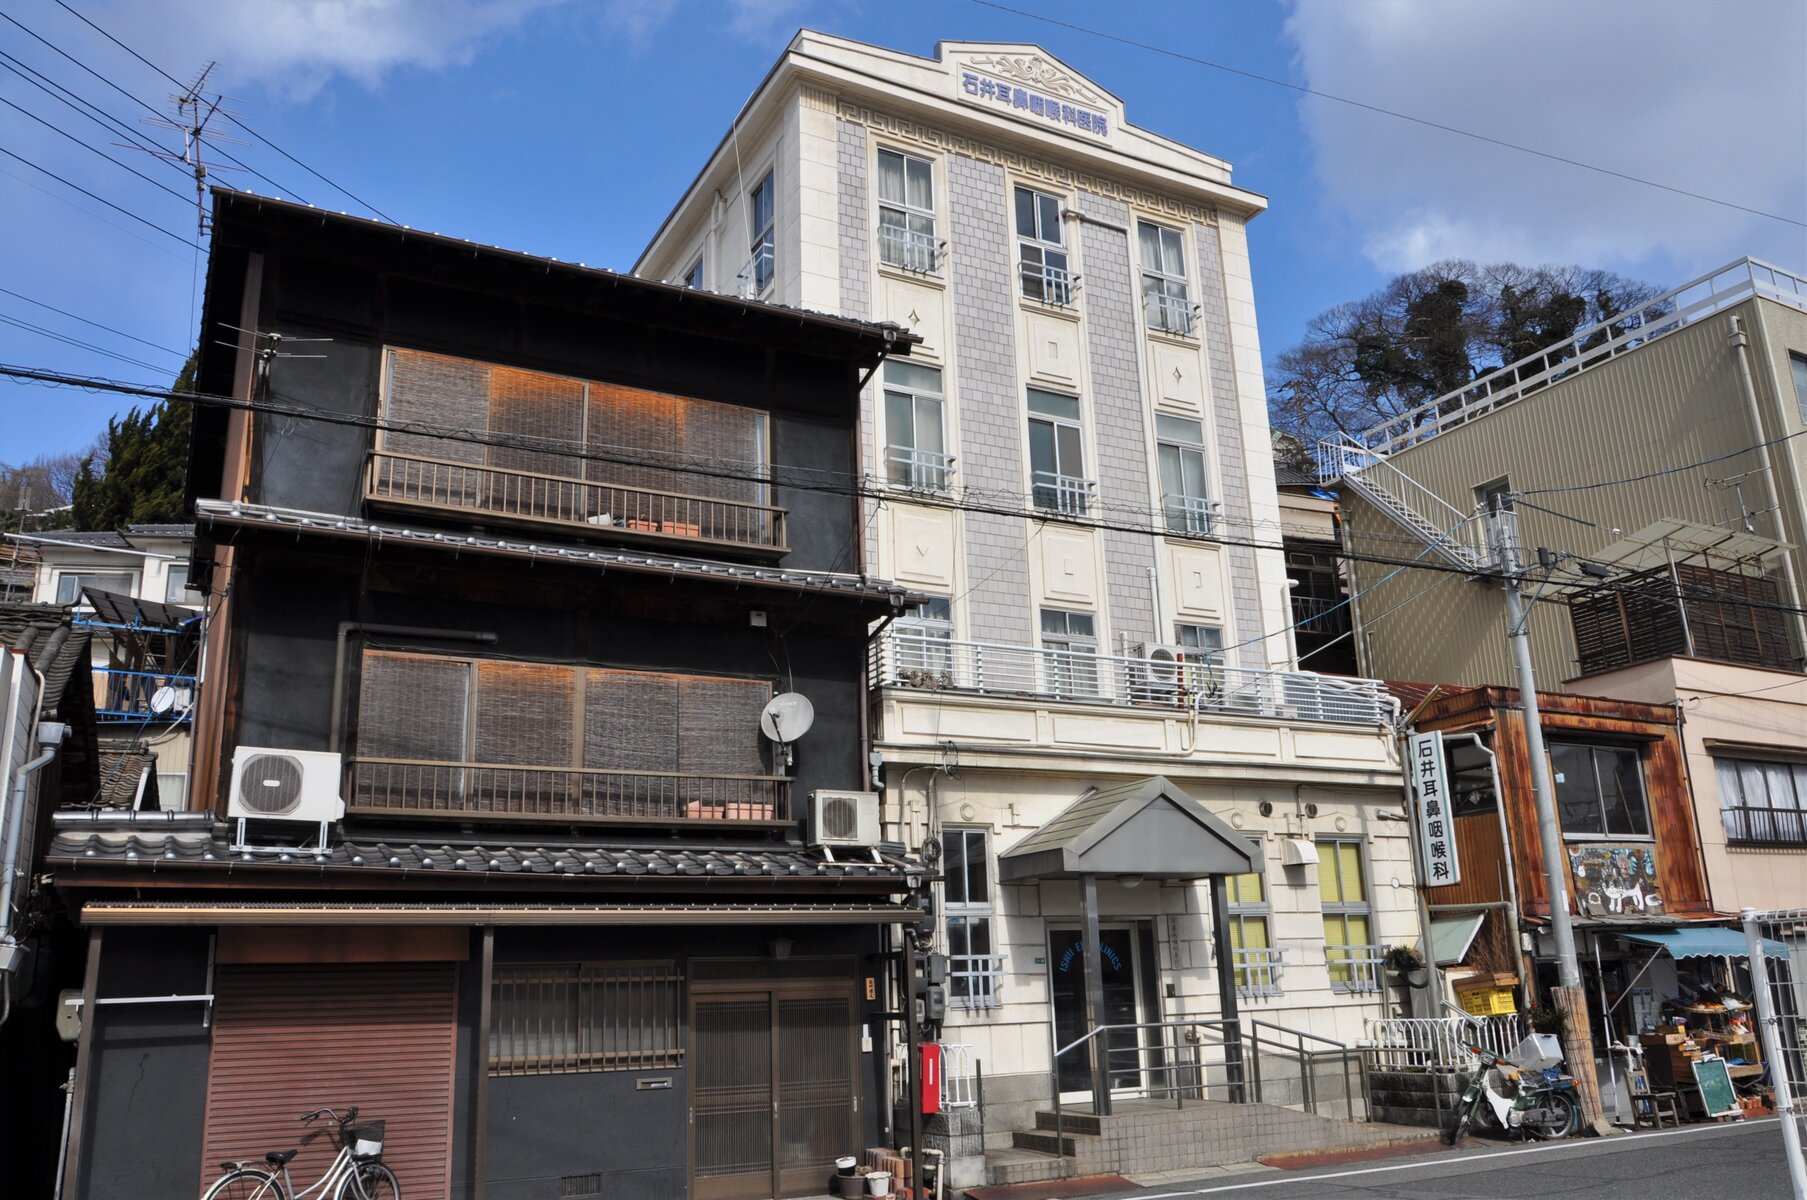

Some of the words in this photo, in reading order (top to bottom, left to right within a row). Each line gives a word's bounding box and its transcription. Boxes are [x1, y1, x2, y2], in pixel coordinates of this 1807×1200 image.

[962, 72, 1108, 137] 石井耳鼻咽喉科医院
[1418, 739, 1450, 880] 石井耳鼻咽喉科
[1059, 948, 1074, 973] ISHII
